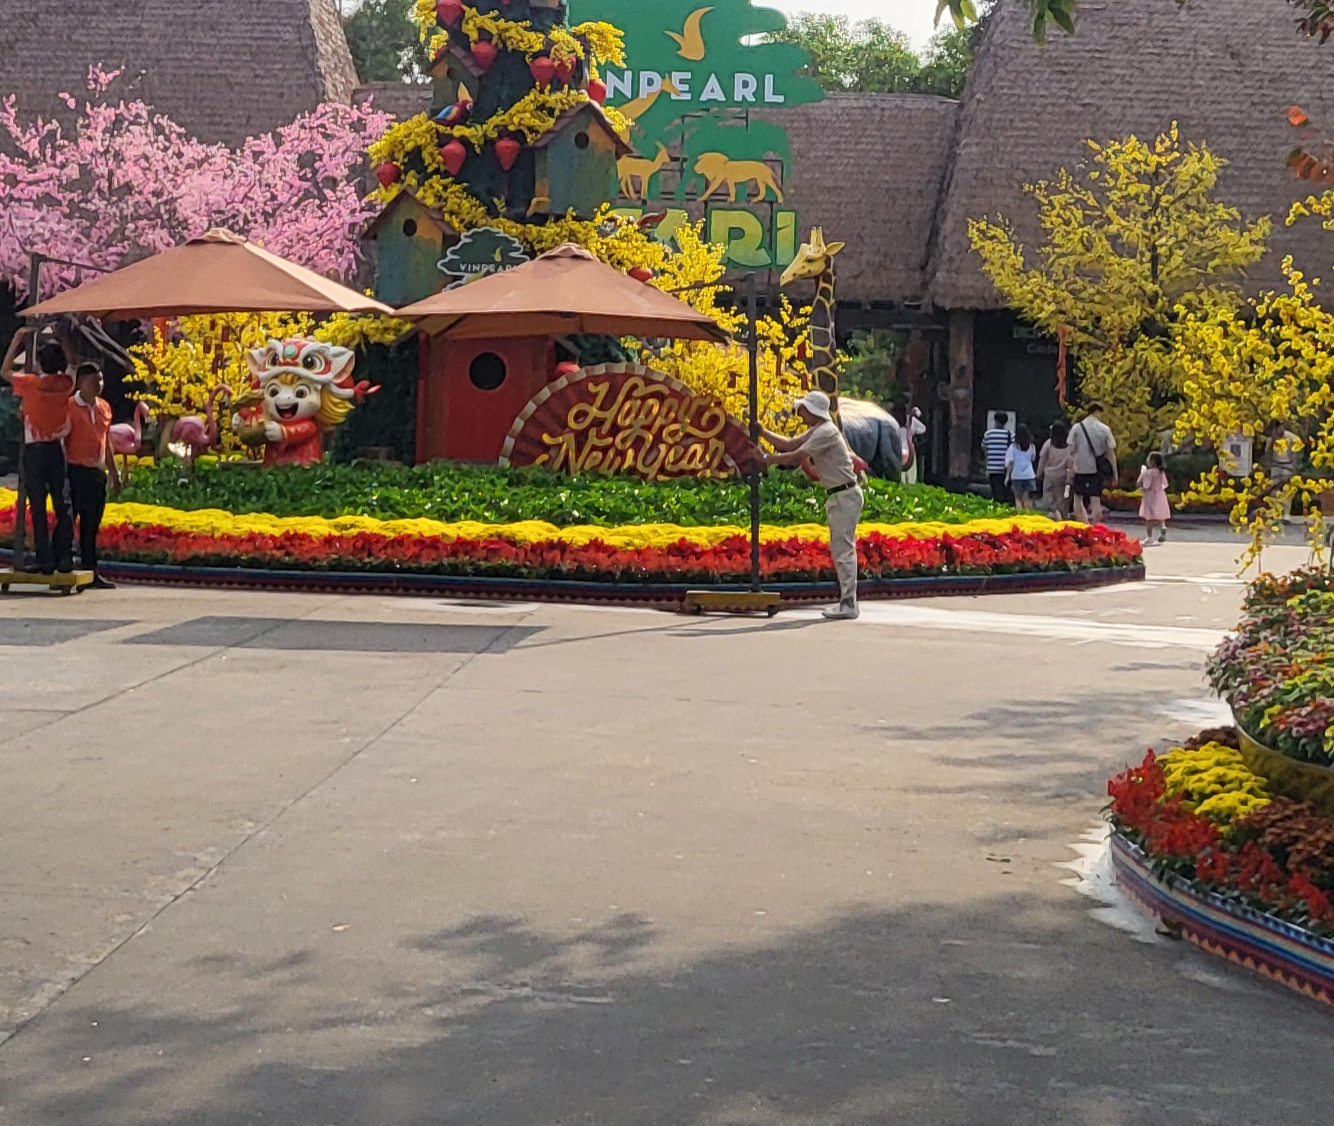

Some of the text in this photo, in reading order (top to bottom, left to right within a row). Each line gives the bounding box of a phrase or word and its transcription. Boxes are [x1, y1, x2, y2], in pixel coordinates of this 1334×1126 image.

[606, 69, 786, 103] NPEARL
[568, 376, 726, 443] Happy
[534, 428, 734, 481] New Year
